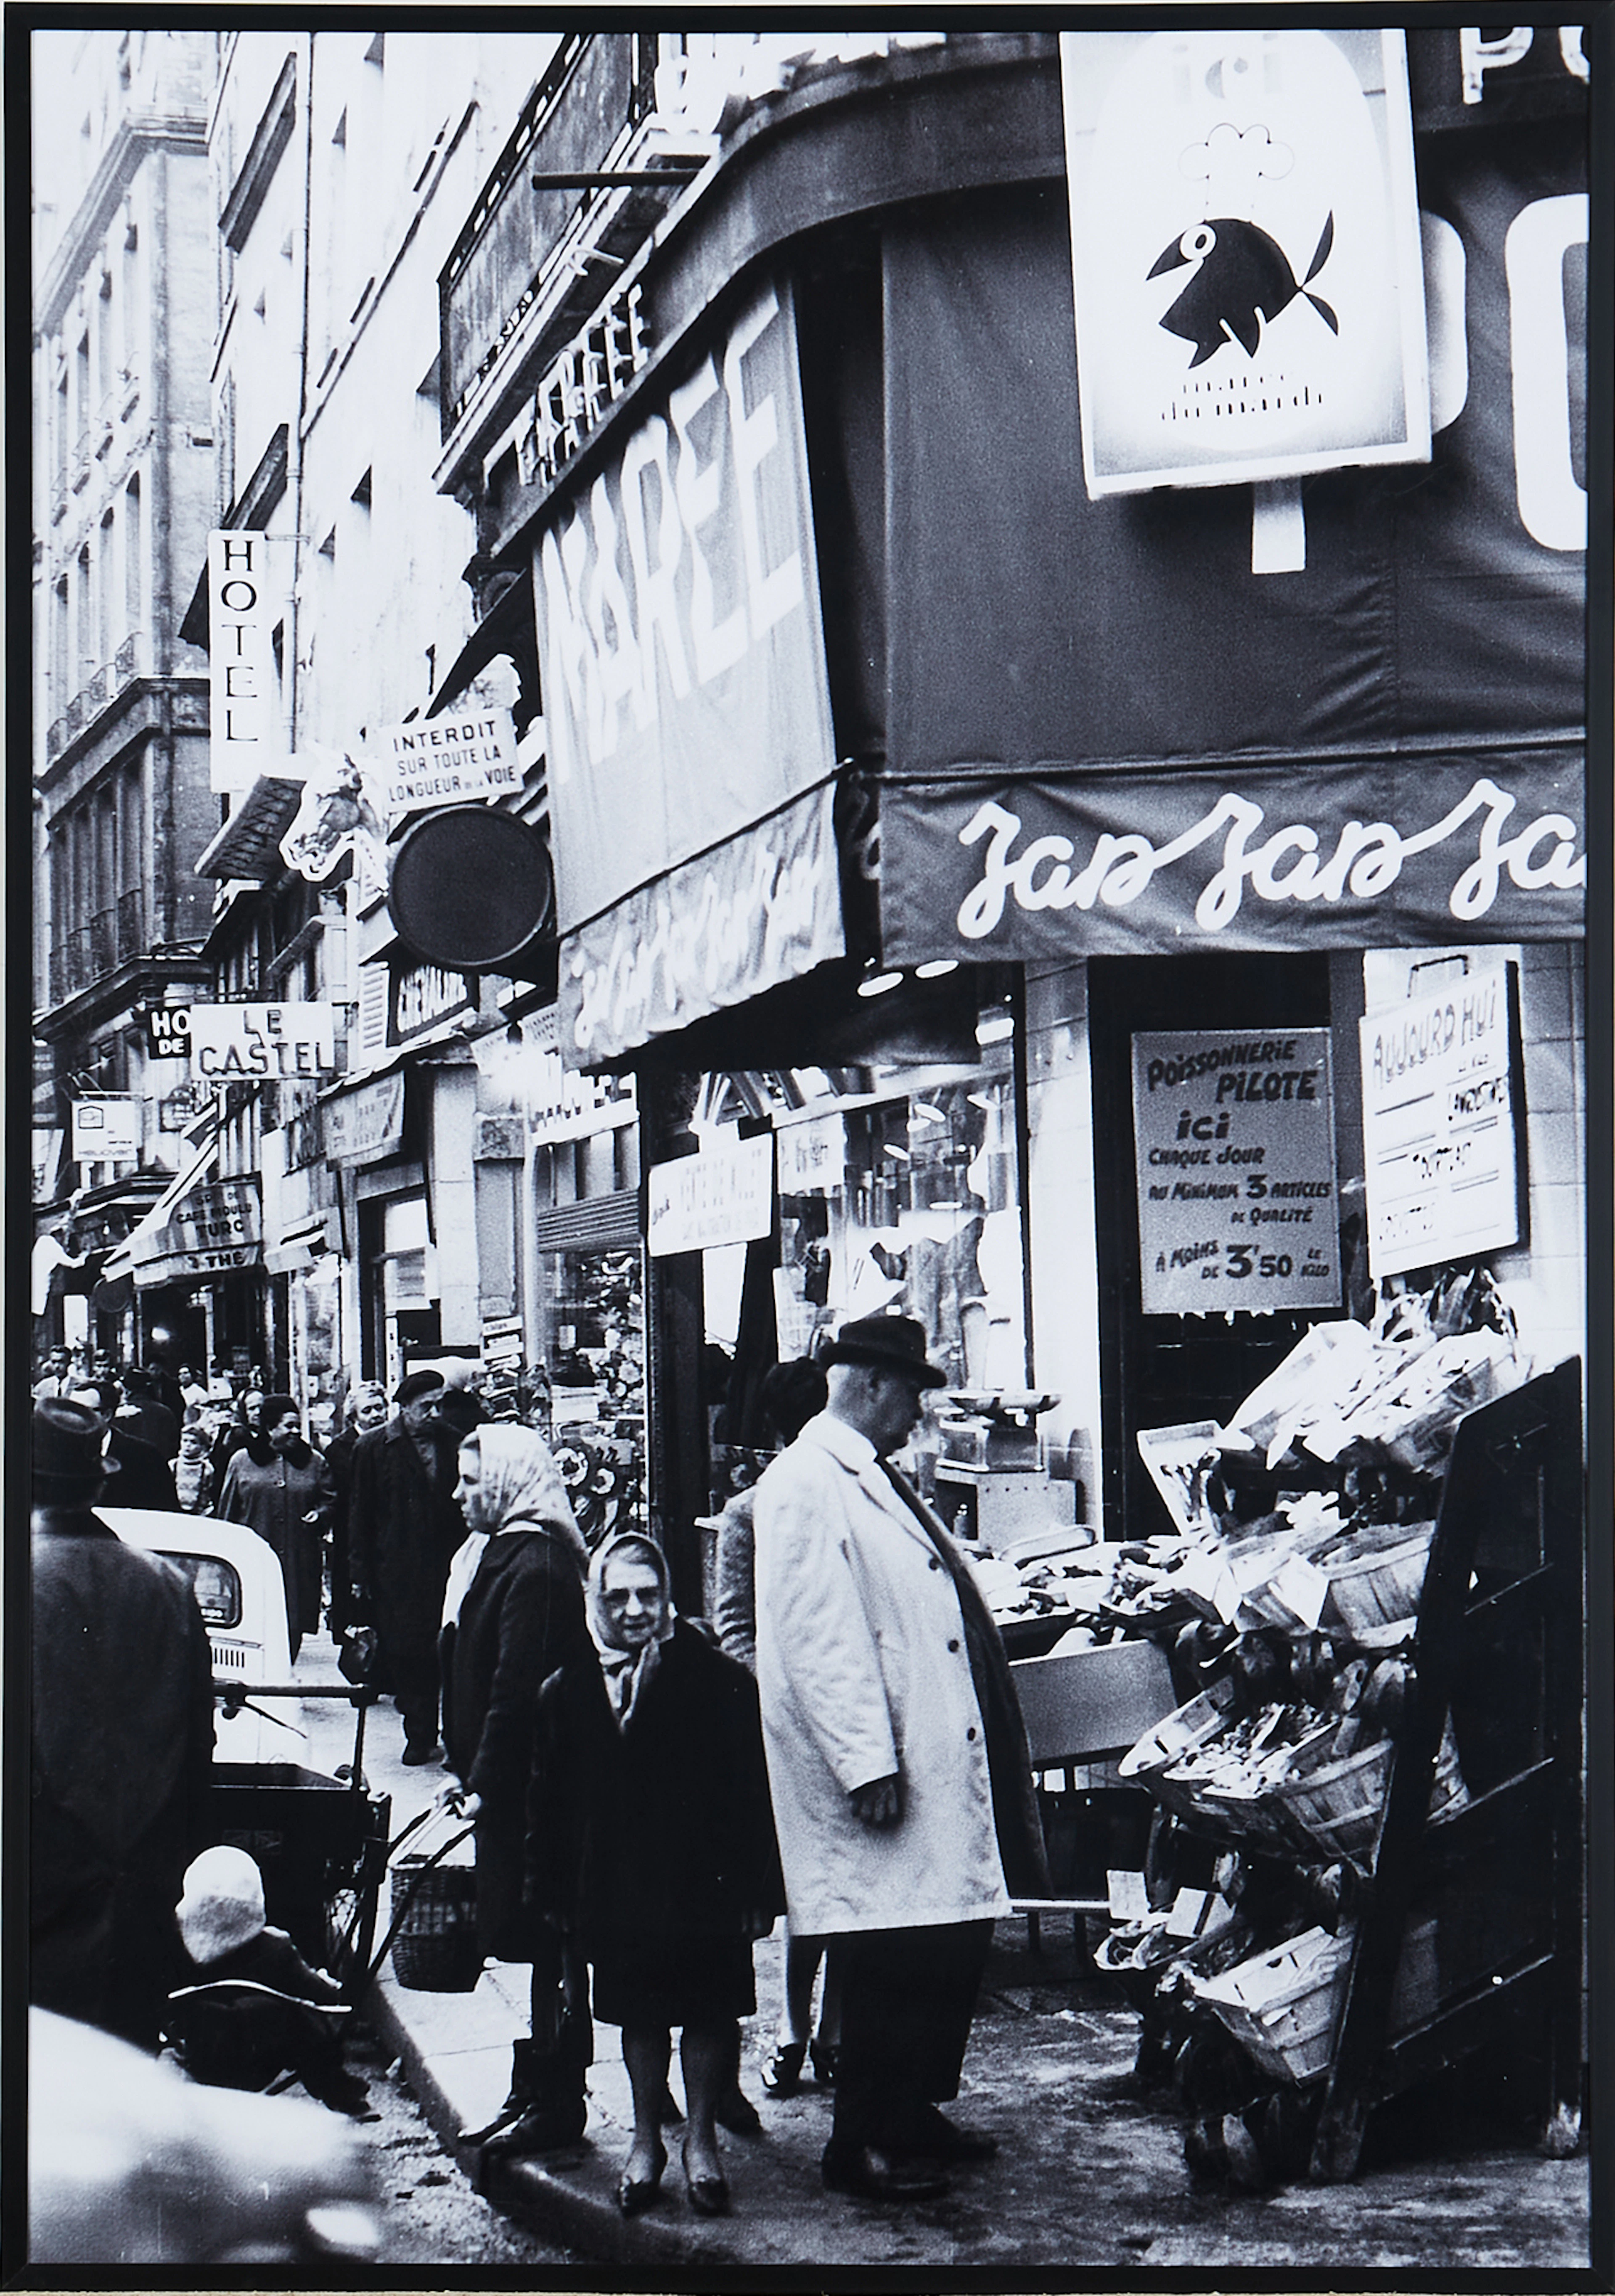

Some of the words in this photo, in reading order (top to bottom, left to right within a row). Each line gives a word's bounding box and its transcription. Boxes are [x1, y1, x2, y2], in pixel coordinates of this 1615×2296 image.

[221, 540, 257, 741] HOTEL
[393, 720, 495, 752] INTERDIT
[398, 757, 427, 776] SUR
[434, 748, 478, 769] TOUTE
[484, 744, 501, 761] LA
[389, 775, 461, 801] LONGUEUR
[485, 766, 516, 784] VOIE
[243, 1010, 282, 1034] LE
[158, 1038, 185, 1055] DE
[200, 1042, 334, 1075] CASTEL
[1149, 1148, 1210, 1169] CHAQUE
[1216, 1145, 1265, 1164] JOUR
[1246, 1174, 1267, 1199] 3
[196, 1219, 244, 1238] TURC
[1307, 1248, 1322, 1259] LE
[1201, 1266, 1219, 1279] DE
